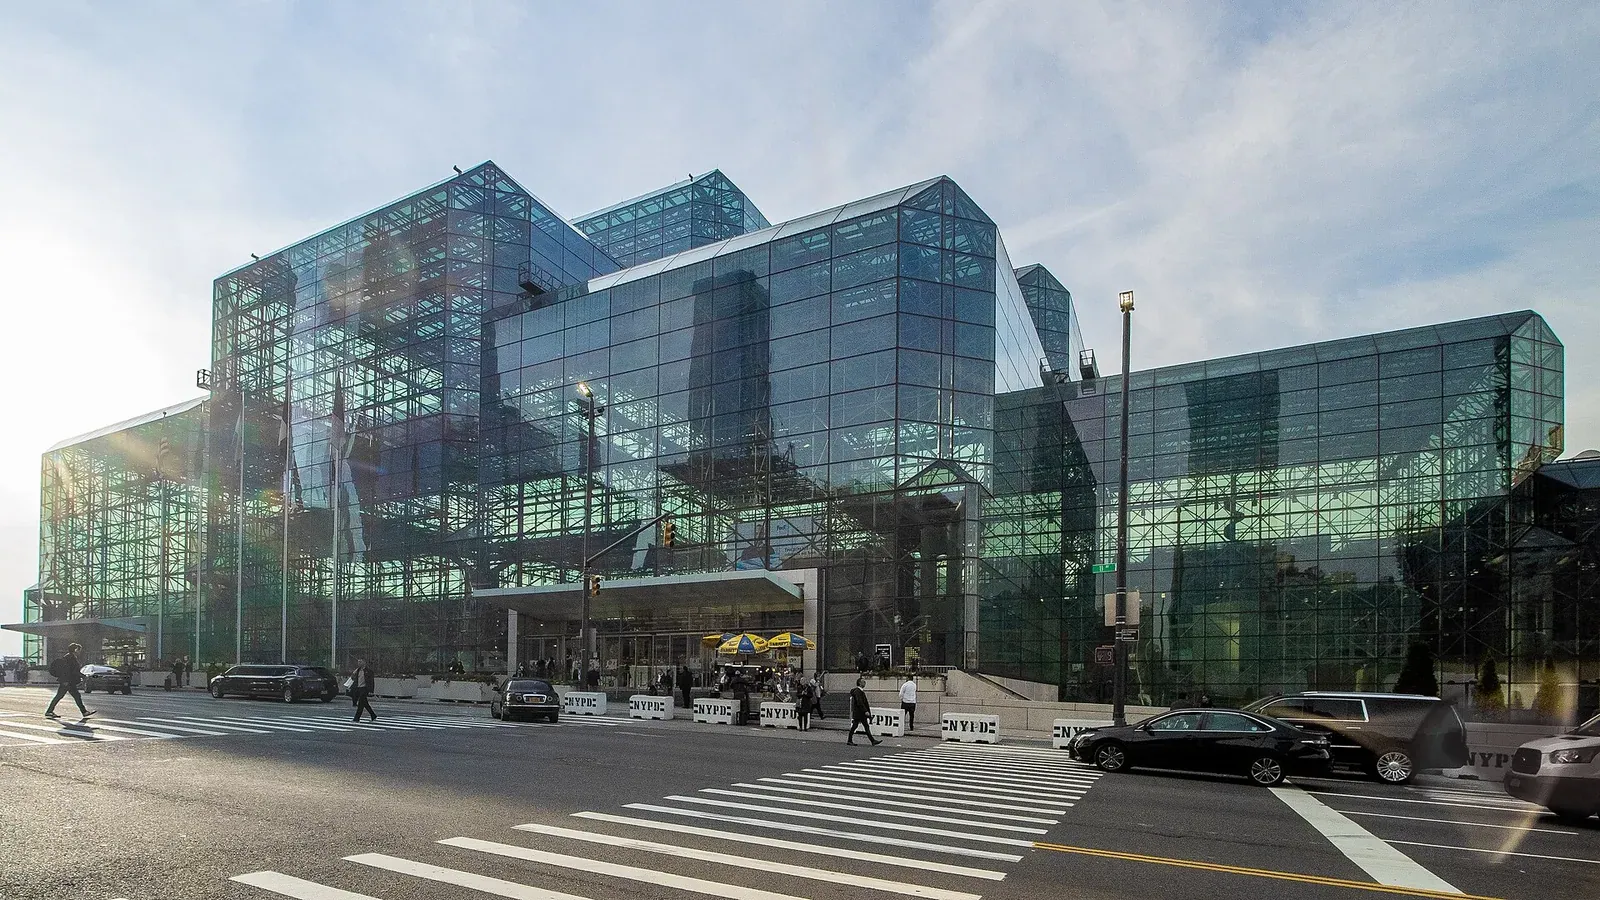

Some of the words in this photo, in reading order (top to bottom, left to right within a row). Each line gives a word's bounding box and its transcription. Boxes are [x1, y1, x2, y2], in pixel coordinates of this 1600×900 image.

[568, 697, 593, 708] NYPD
[633, 700, 660, 711] NYPD
[698, 704, 727, 716] NYPD
[869, 714, 892, 726] YPD
[949, 719, 989, 734] NYPD
[1467, 752, 1513, 768] NYP
